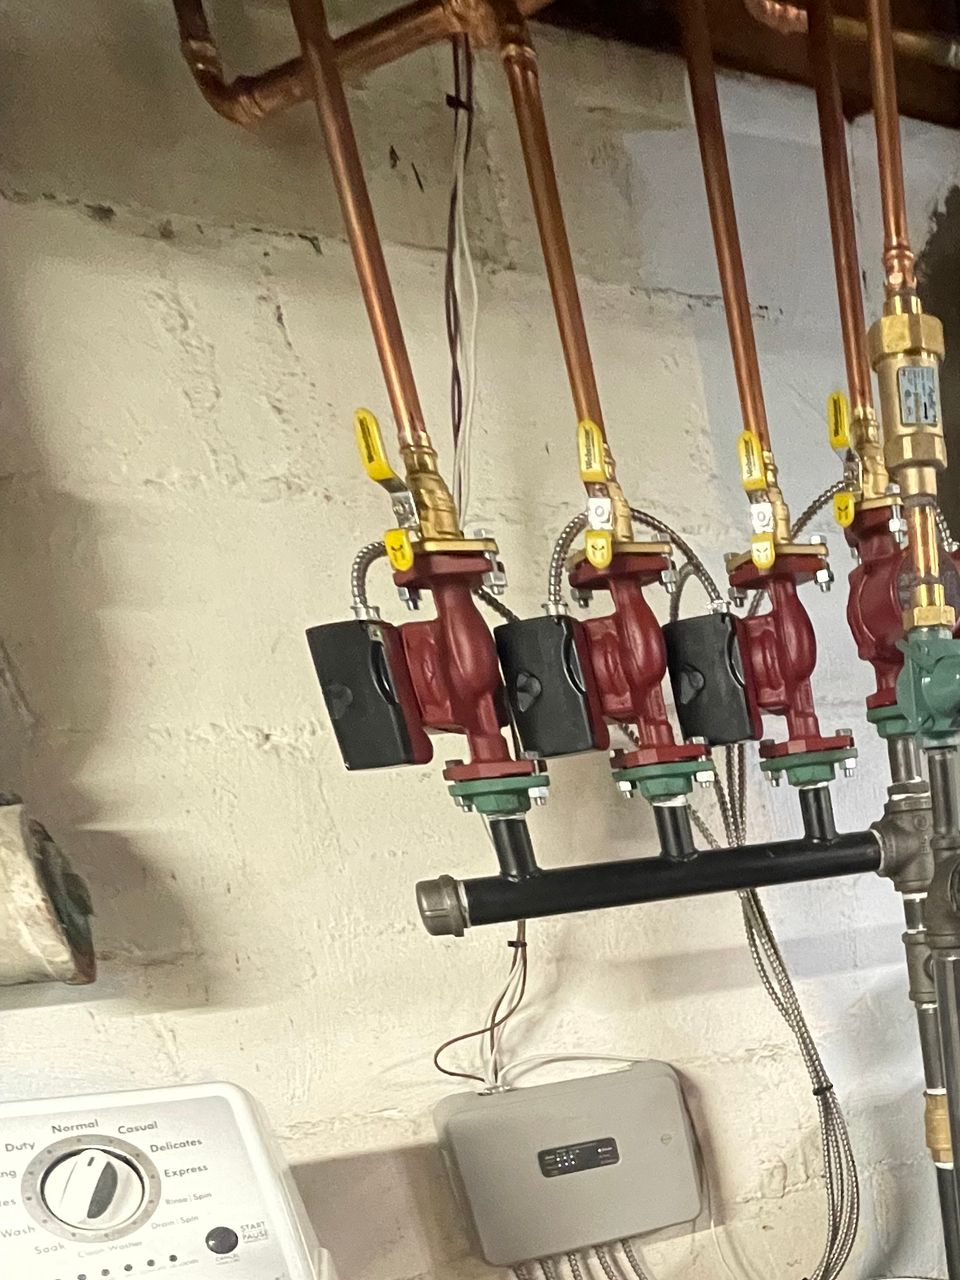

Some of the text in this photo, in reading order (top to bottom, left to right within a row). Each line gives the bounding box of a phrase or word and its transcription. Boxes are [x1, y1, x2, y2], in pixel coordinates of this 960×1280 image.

[51, 1119, 99, 1134] Normal
[117, 1121, 158, 1134] Casual
[5, 1142, 35, 1152] Duty
[150, 1139, 203, 1153] Delicates
[164, 1165, 208, 1177] Express
[192, 1191, 212, 1201] Spin
[180, 1215, 199, 1224] Spin
[0, 1225, 35, 1239] Wash
[240, 1221, 265, 1232] START
[242, 1229, 268, 1241] PAUSE
[34, 1242, 65, 1255] Soak
